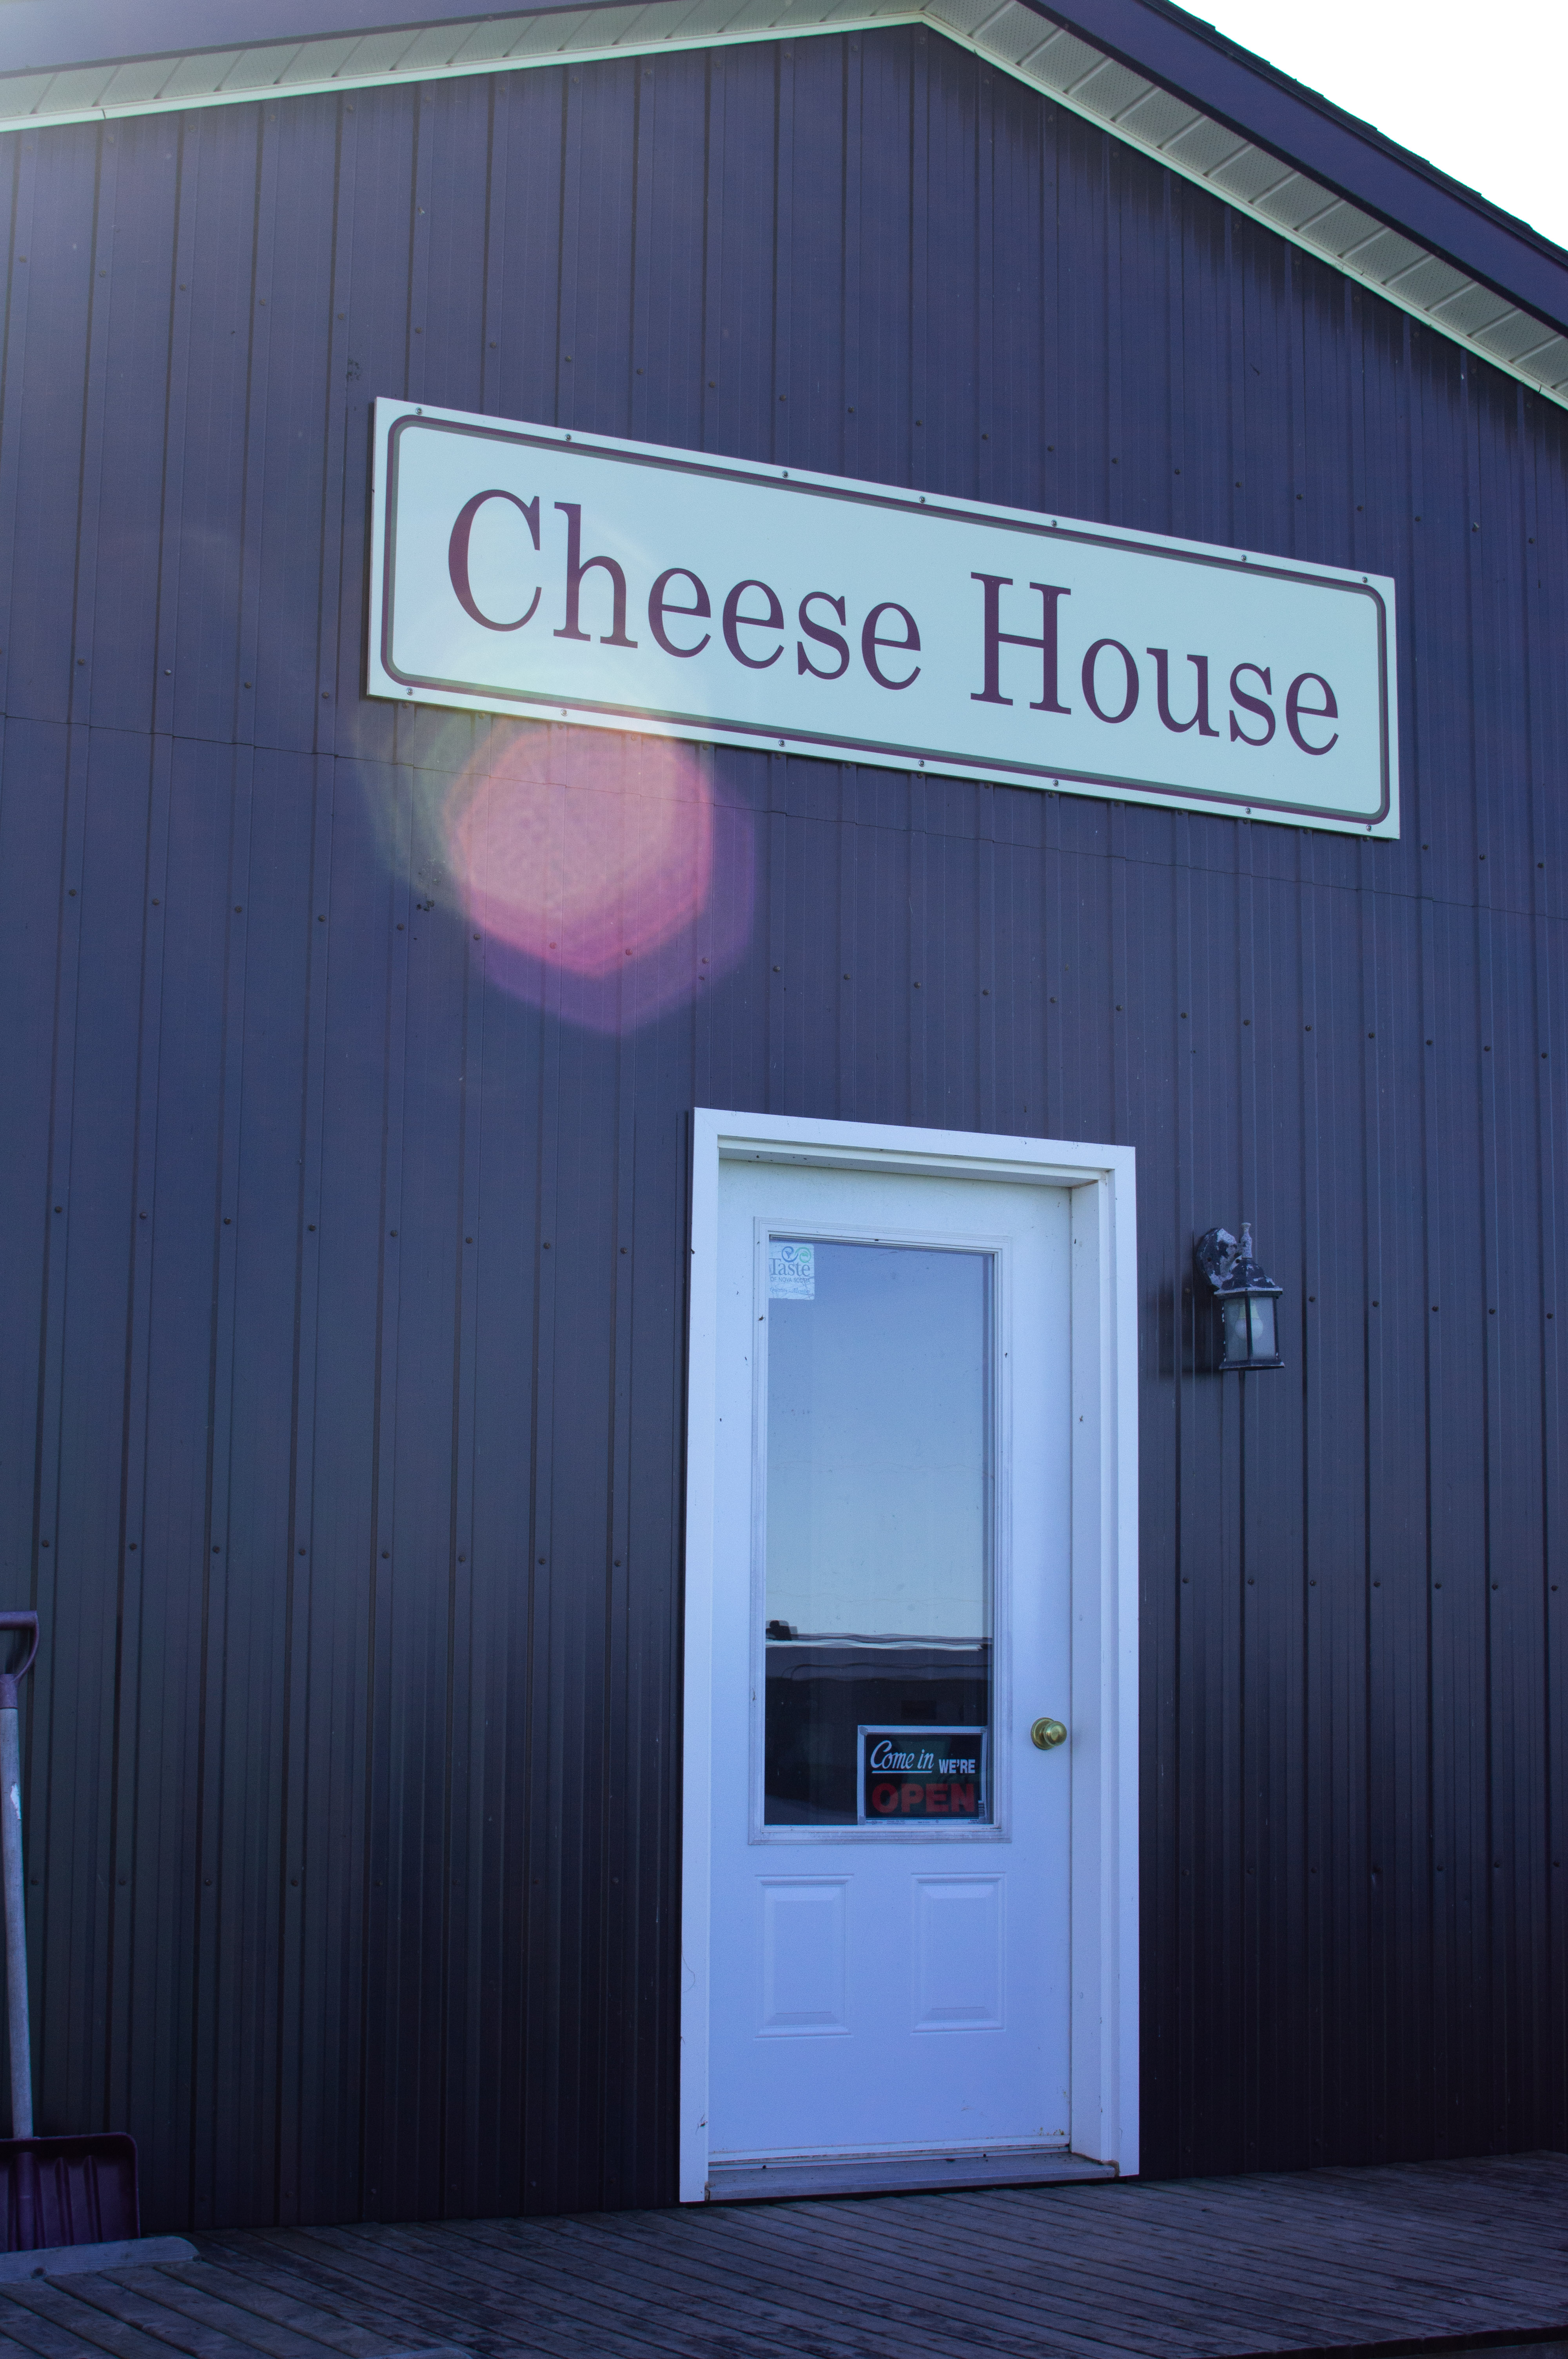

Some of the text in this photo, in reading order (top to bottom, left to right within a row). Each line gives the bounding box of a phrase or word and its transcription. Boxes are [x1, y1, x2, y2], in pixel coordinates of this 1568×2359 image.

[448, 489, 1339, 756] Cheese House
[769, 1258, 810, 1277] Taste
[870, 1740, 976, 1774] Come in WE'RE
[872, 1783, 975, 1813] OPEN
